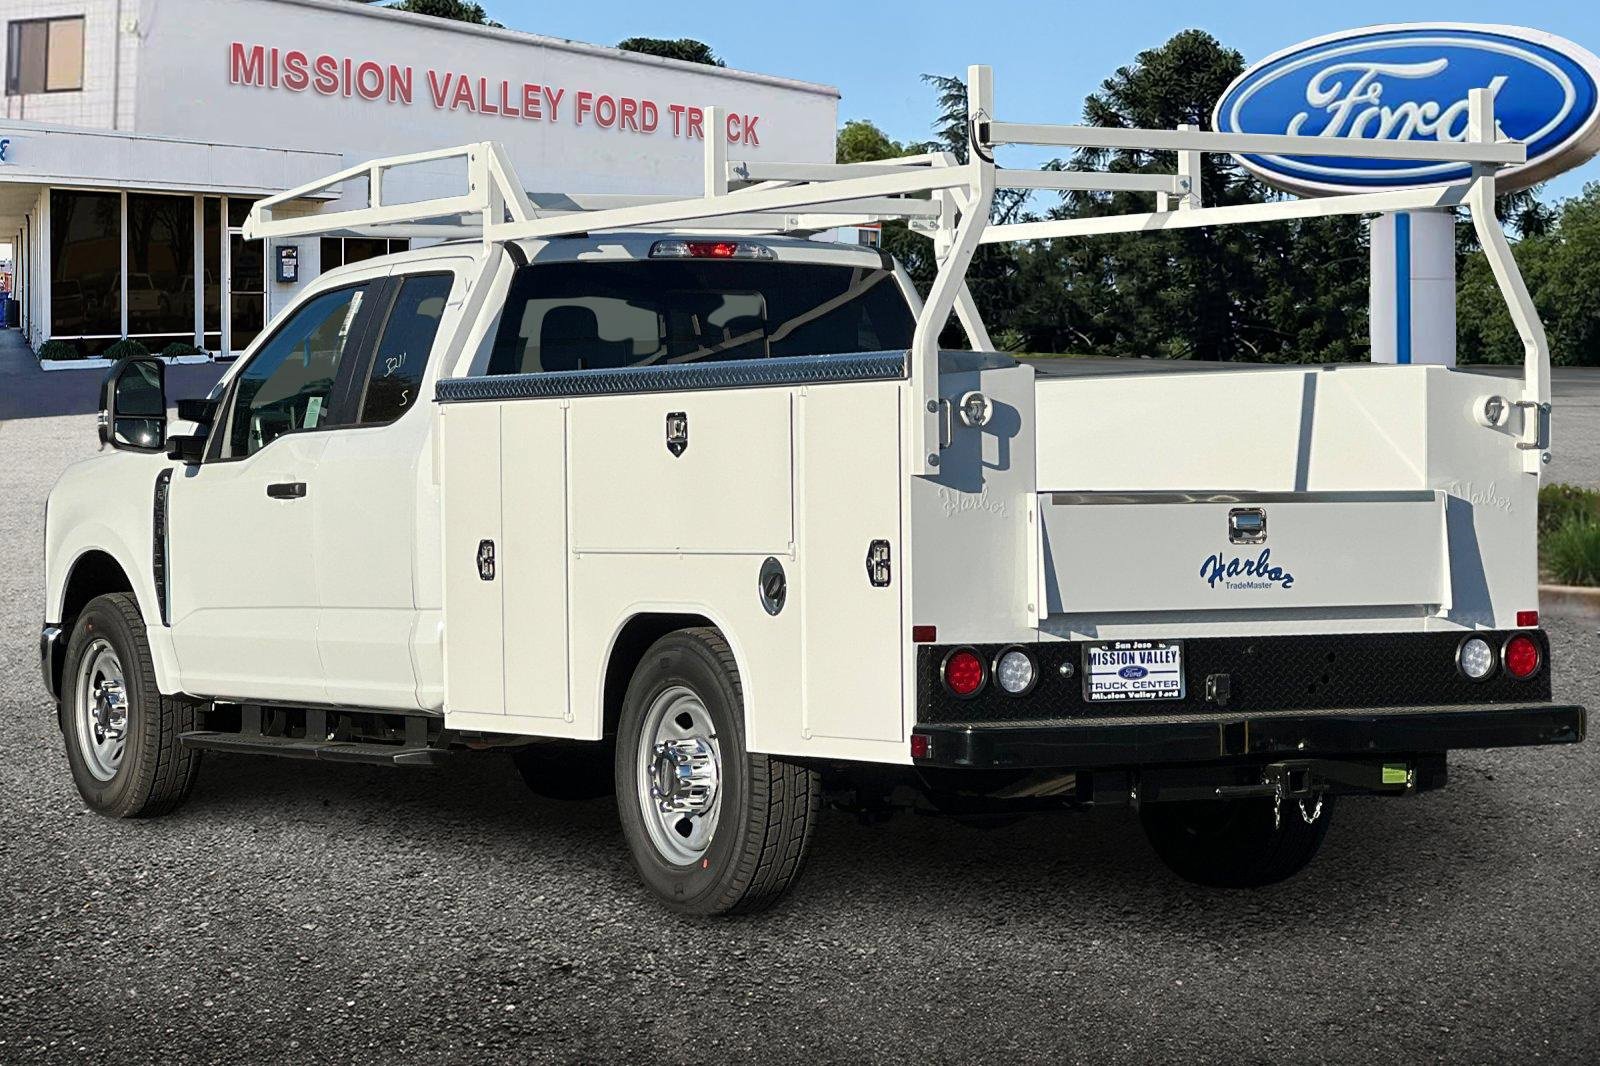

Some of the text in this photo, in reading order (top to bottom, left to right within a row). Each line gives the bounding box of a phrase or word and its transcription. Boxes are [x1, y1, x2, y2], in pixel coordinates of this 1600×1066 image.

[229, 41, 760, 146] MISSION VALLEY FORD TRCK
[1286, 57, 1509, 142] Ford
[1200, 547, 1295, 589] Harbor
[1225, 581, 1272, 590] TradeMaster
[1114, 641, 1152, 650] San Jose
[1088, 650, 1178, 666] MISSION VALLEY
[1123, 668, 1143, 678] Ford
[1089, 680, 1179, 691] TRUCK CENTER
[1091, 692, 1126, 700] Mission
[1128, 690, 1157, 700] Valley
